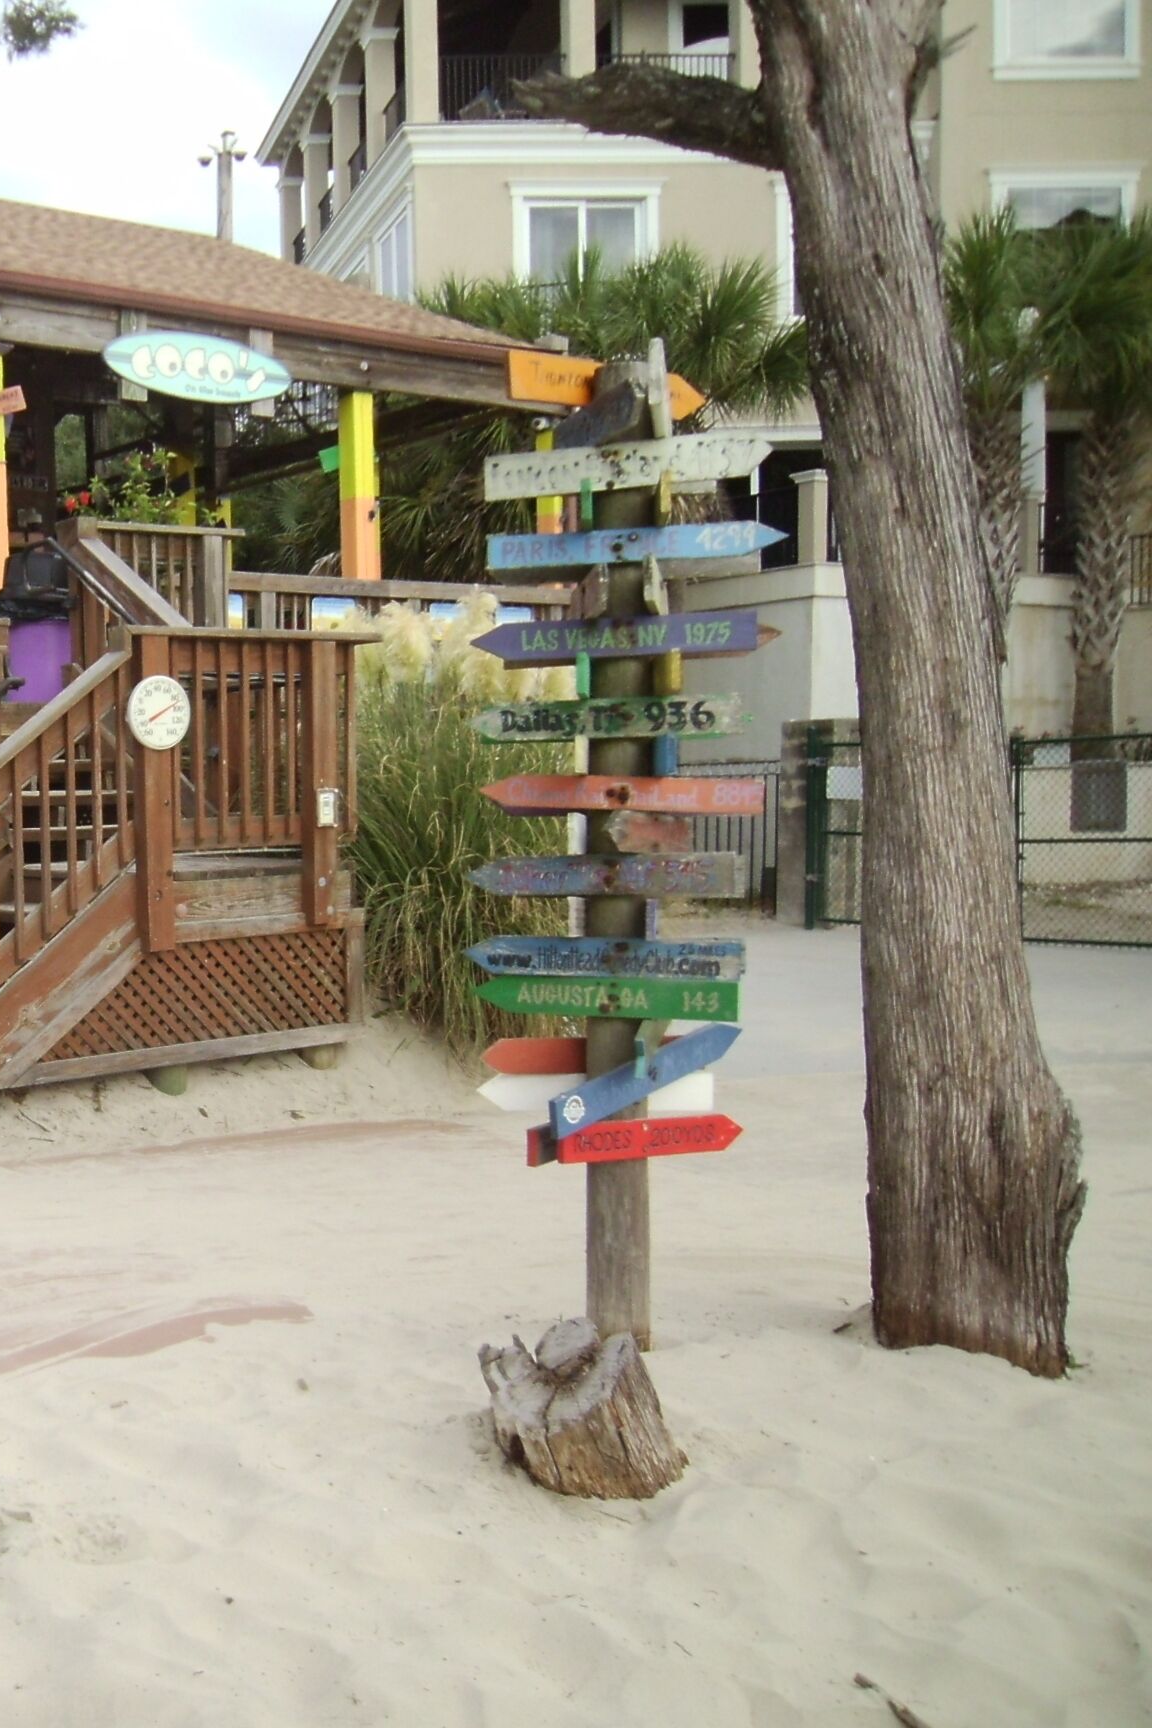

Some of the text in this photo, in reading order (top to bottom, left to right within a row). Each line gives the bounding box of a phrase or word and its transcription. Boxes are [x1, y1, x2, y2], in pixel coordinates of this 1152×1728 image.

[519, 627, 560, 653] LAS
[637, 622, 668, 648] NV
[683, 620, 732, 646] 1975
[643, 700, 716, 732] 936
[516, 981, 721, 1013] AUGUSTA GA 143
[572, 1129, 633, 1153] RHODES
